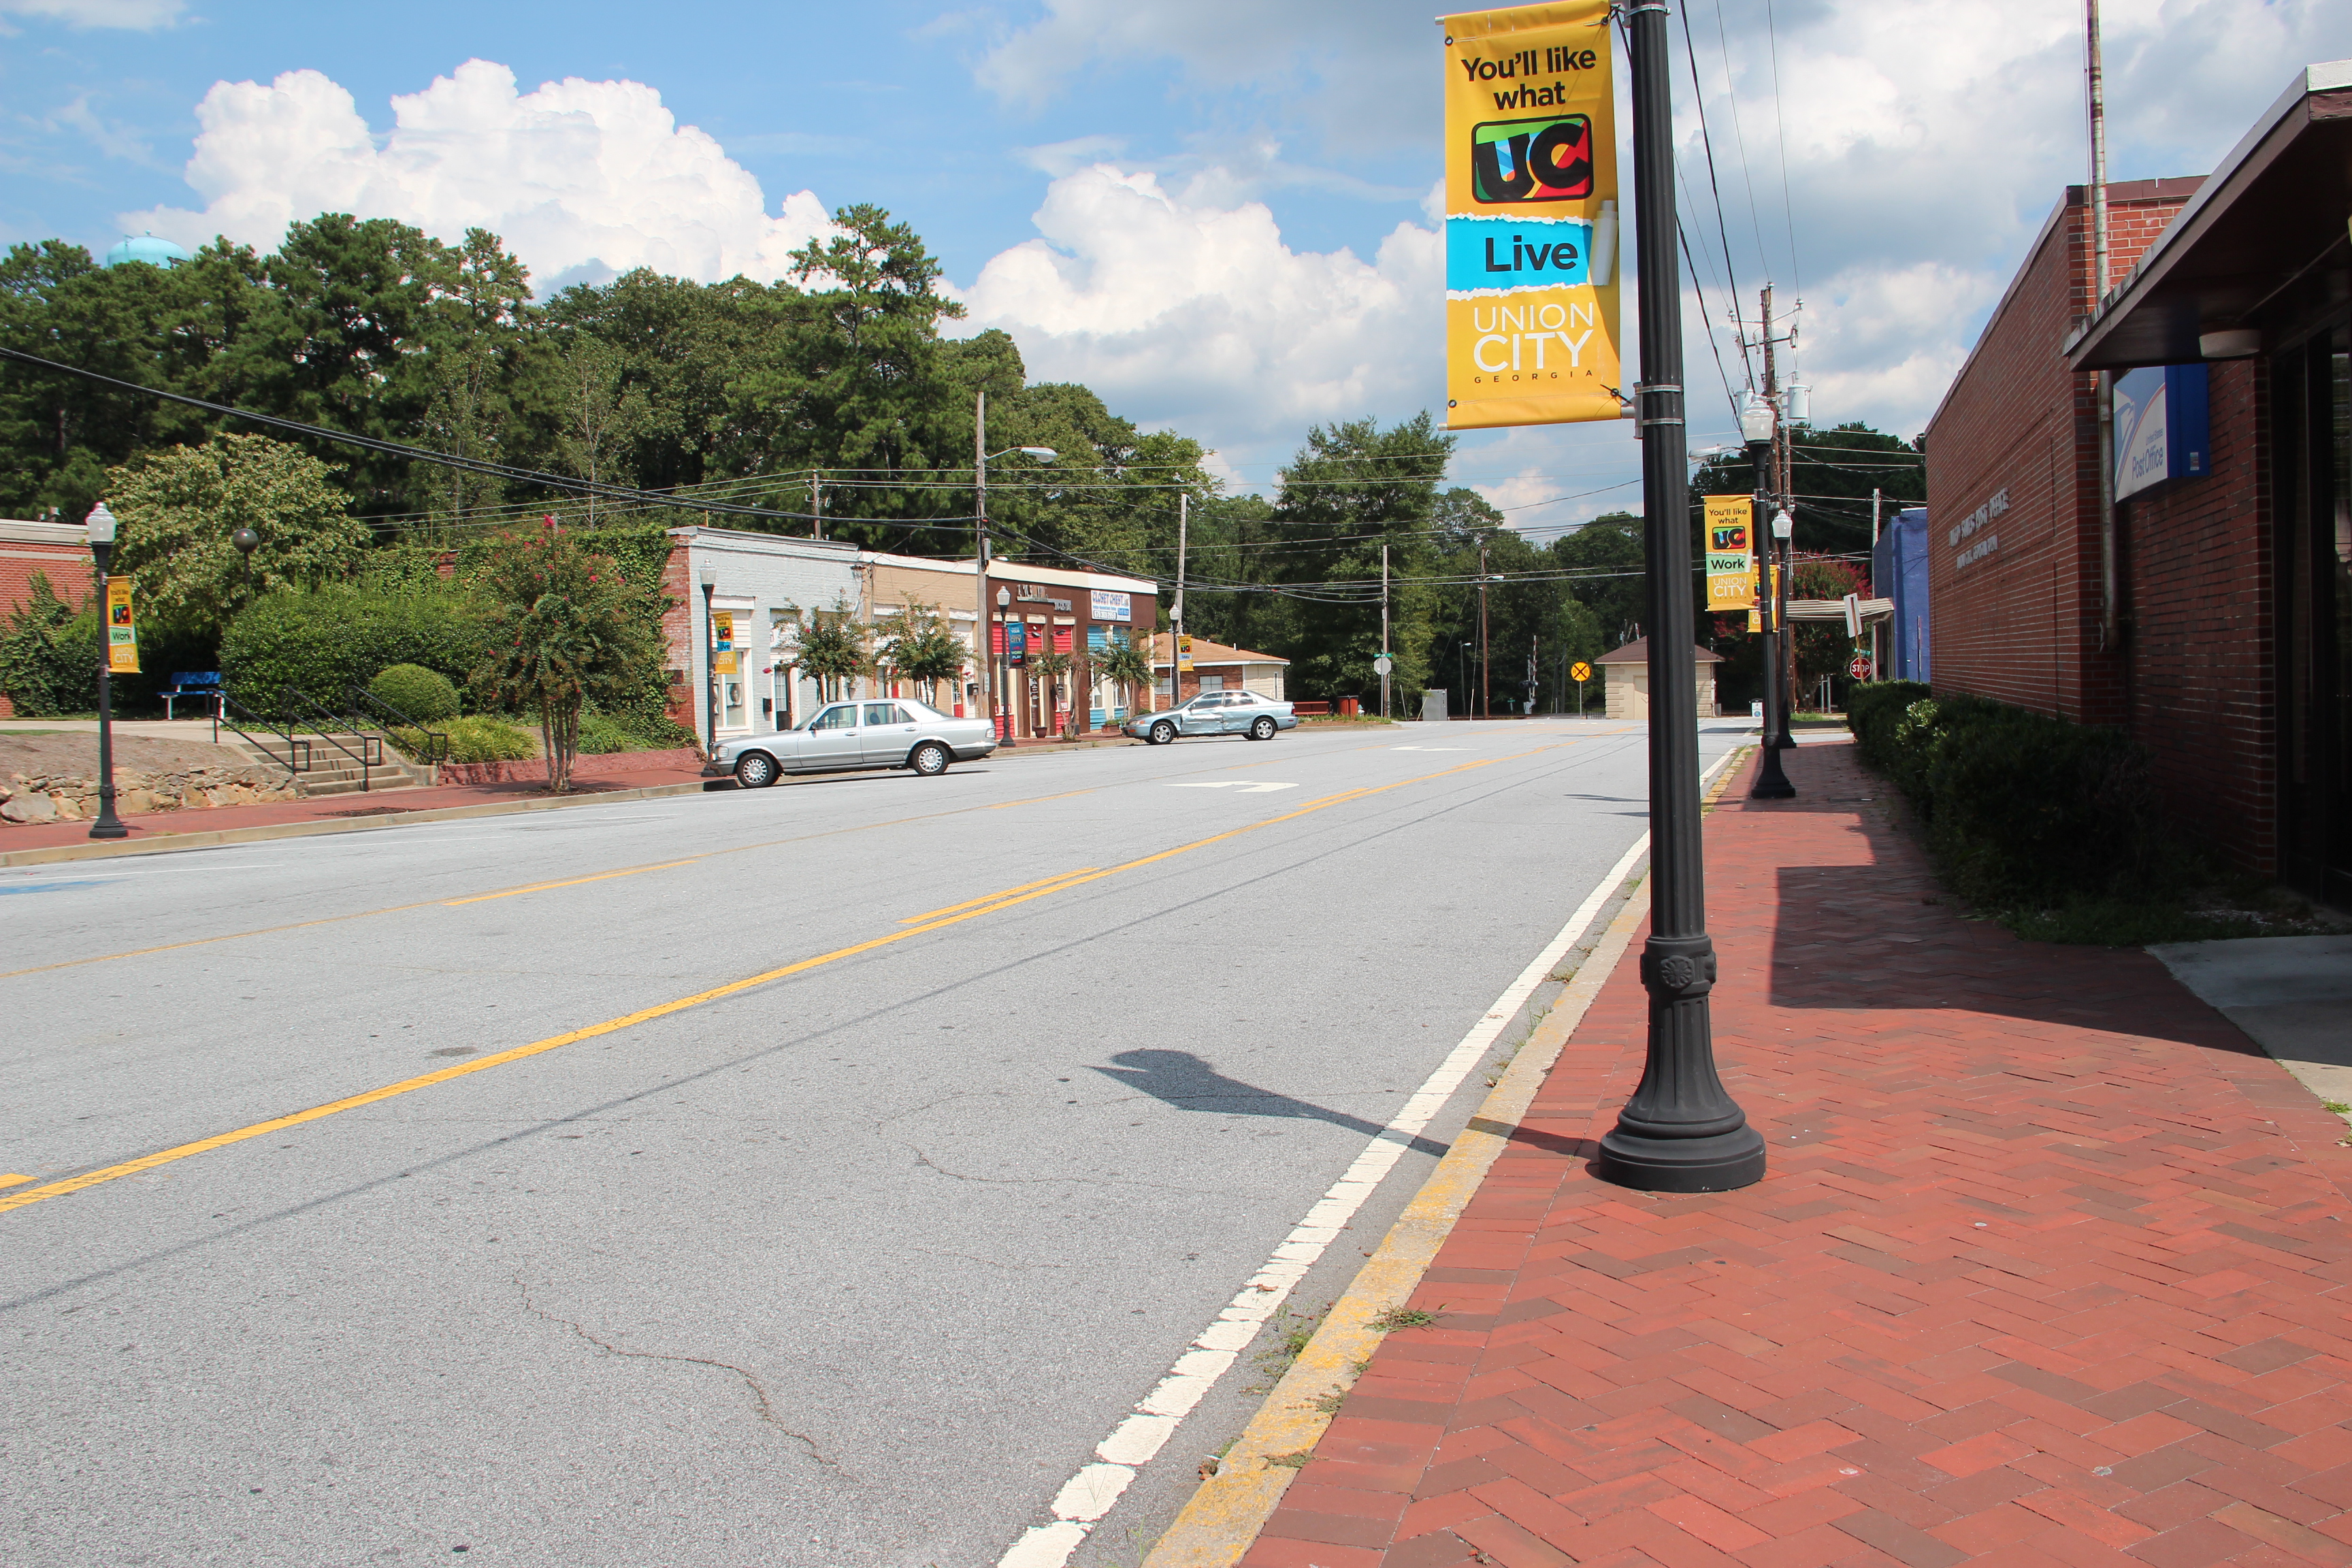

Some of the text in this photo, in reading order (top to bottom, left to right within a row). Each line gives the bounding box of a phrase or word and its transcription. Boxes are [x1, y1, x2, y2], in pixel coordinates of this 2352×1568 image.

[1461, 46, 1597, 82] You'll like
[1493, 81, 1566, 110] what
[1475, 122, 1590, 200] UC
[1486, 235, 1578, 272] Live
[1474, 302, 1593, 333] UNION
[1473, 329, 1594, 372] CITY
[1474, 370, 1592, 383] GEORGIA
[2132, 453, 2144, 480] Post
[2145, 444, 2163, 473] Office
[1713, 528, 1746, 549] UC
[1711, 559, 1745, 570] Work
[1713, 577, 1747, 586] UNION
[1092, 591, 1124, 606] CLOSET CHEST
[1714, 585, 1746, 597] CITY
[112, 632, 132, 640] Work
[115, 653, 134, 663] CITY
[1852, 664, 1869, 672] STOP
